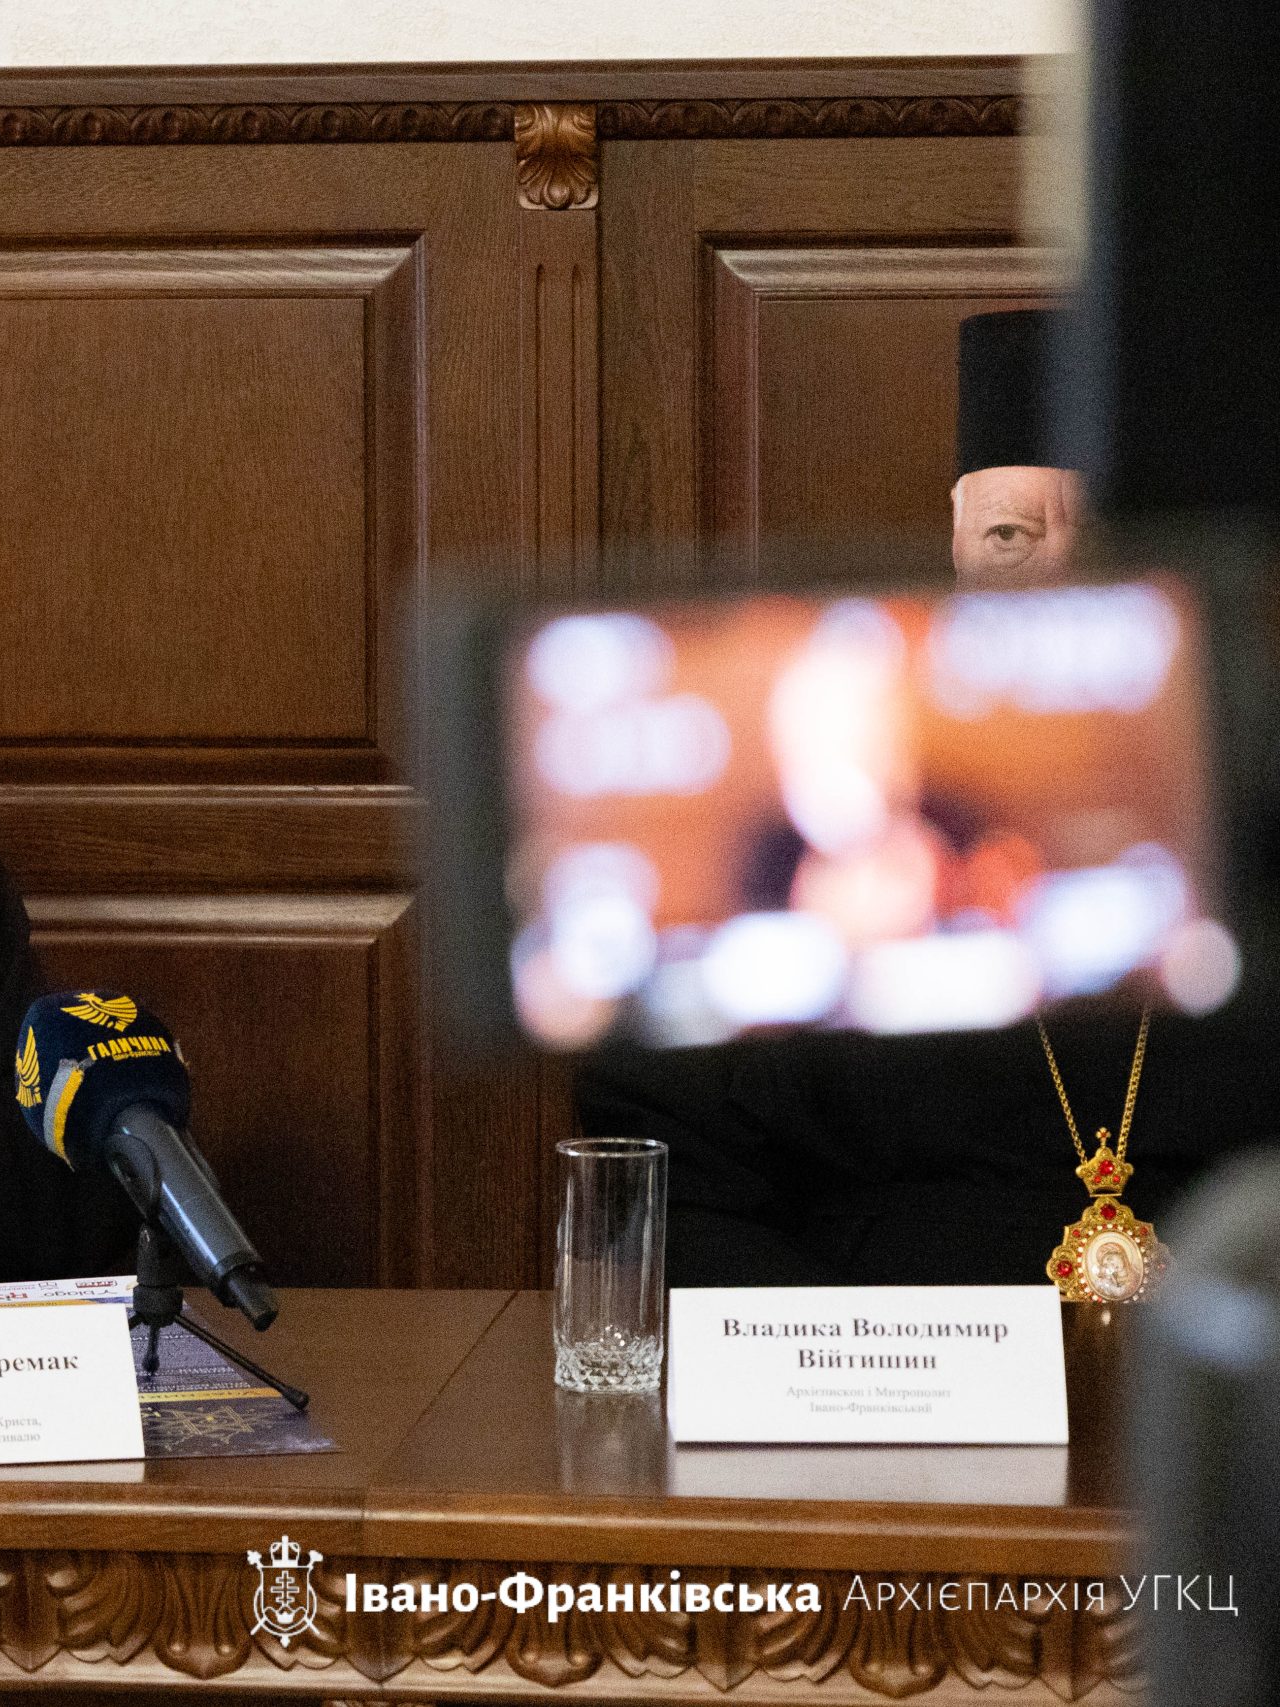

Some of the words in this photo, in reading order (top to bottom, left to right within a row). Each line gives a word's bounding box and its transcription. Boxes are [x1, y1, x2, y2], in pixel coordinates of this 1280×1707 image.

[87, 1036, 171, 1061] ГАЛИЧИНА
[723, 1318, 842, 1338] Владика
[852, 1318, 1009, 1344] Володимир
[798, 1348, 937, 1370] Війтишин
